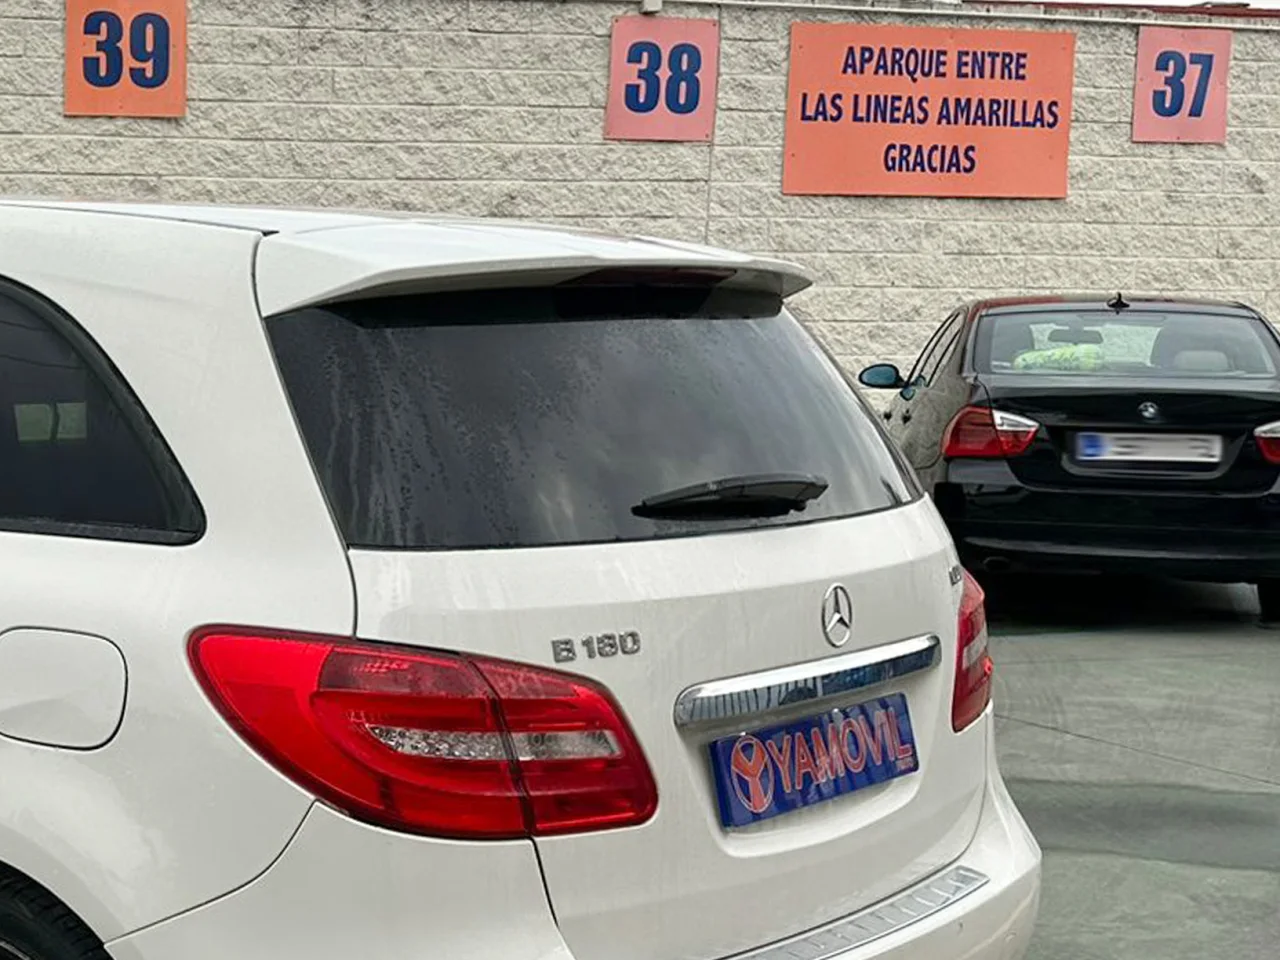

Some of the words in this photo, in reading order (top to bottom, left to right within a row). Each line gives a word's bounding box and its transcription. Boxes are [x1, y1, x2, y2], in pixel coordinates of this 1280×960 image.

[82, 10, 170, 89] 39
[841, 46, 948, 83] APARQUE
[956, 50, 1028, 81] ENTRE
[624, 40, 702, 115] 38
[1152, 50, 1214, 119] 37
[800, 92, 844, 123] LAS
[852, 94, 929, 125] LINEAS
[936, 97, 1059, 129] AMARILLAS
[883, 143, 976, 174] GRACIAS
[551, 638, 576, 663] B
[581, 631, 641, 659] 180
[766, 706, 913, 793] YAMOVIL
